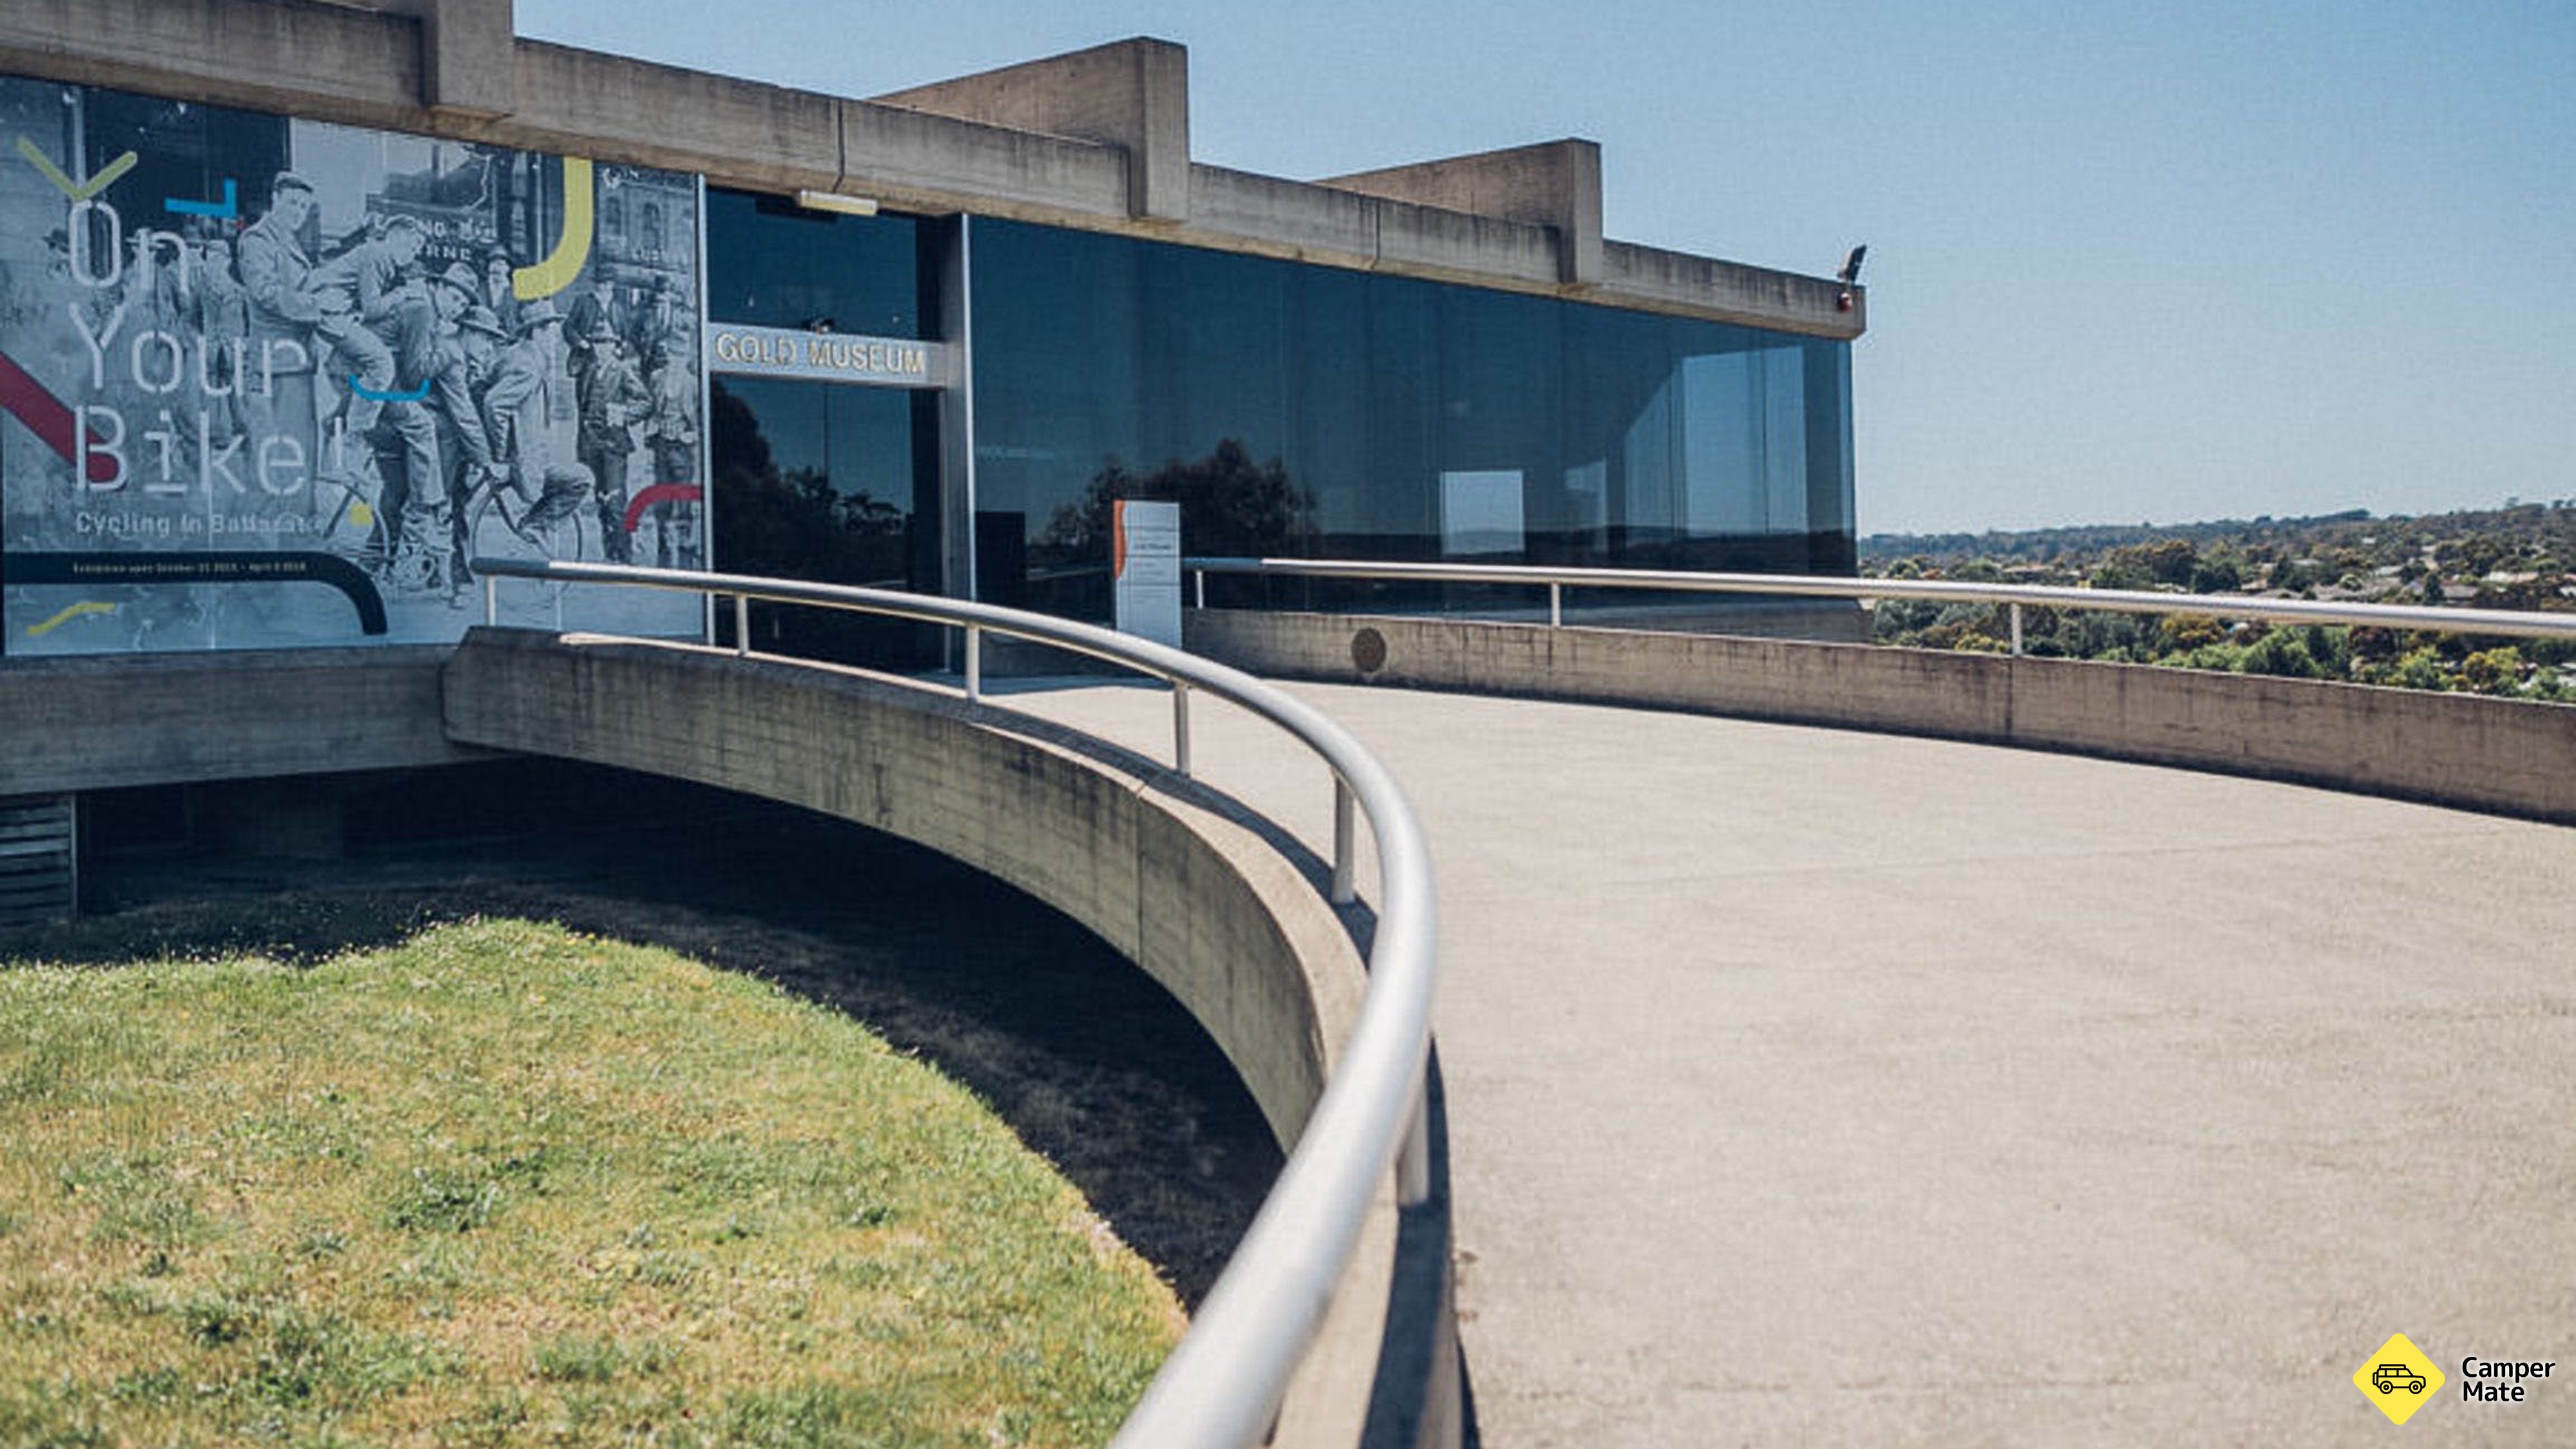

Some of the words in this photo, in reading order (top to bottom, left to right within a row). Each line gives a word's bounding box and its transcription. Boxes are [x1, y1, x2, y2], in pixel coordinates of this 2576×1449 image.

[70, 199, 191, 293] On
[68, 302, 309, 397] Your
[715, 333, 797, 365] GOLD
[809, 339, 926, 375] MUSEUM
[76, 512, 170, 538] Cycling
